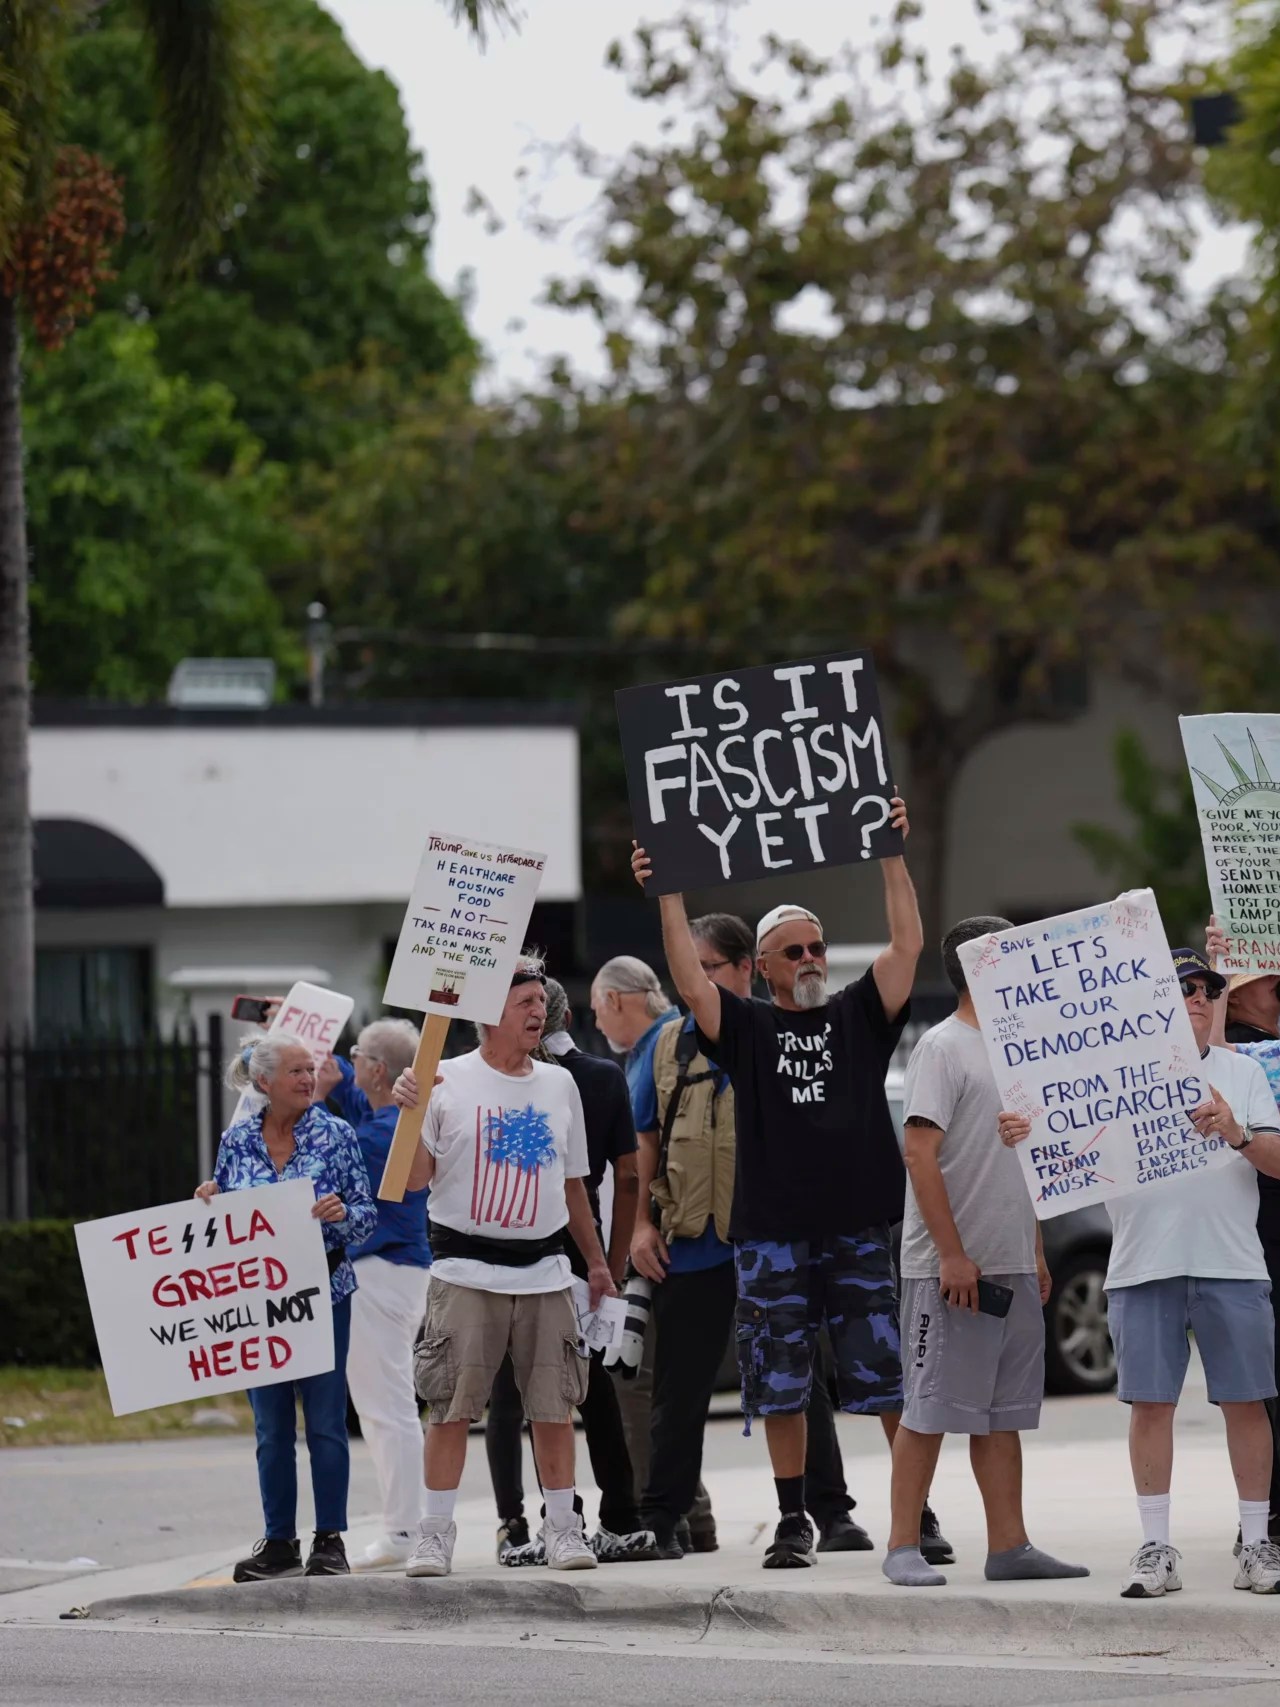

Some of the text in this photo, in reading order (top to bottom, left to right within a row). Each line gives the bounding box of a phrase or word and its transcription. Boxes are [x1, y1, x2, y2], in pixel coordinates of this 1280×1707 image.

[664, 658, 864, 740] IS IT
[1244, 809, 1264, 819] ME
[1211, 834, 1255, 843] MASSES
[1253, 846, 1279, 855] THE
[436, 860, 516, 884] HEALTHCARE
[461, 849, 478, 859] GIVE
[480, 852, 493, 862] US
[495, 853, 544, 871] AFFORDABLE
[1215, 859, 1231, 867] OF
[1235, 858, 1271, 868] YOUR
[1220, 868, 1263, 881] SEND
[448, 877, 505, 898] HOUSING
[458, 893, 491, 908] FOOD
[1224, 897, 1260, 908] TOST
[1263, 897, 1280, 909] TO
[450, 908, 488, 924] NOT
[1229, 908, 1272, 921] LAMP
[412, 917, 507, 944] TAX BREAKS FOR
[411, 943, 497, 969] AND THE RICH
[426, 935, 492, 956] ELON MUSK
[1001, 936, 1035, 954] SAVE
[1031, 935, 1107, 974] LET'S
[1223, 958, 1250, 969] THEY
[995, 957, 1151, 1010] TAKE BACK
[1155, 974, 1178, 986] SAVE
[992, 1012, 1021, 1026] SAVE
[1060, 995, 1119, 1019] OUR
[280, 1006, 339, 1044] FIRE
[997, 1021, 1026, 1034] NPR
[1002, 1007, 1176, 1067] DEMOCRACY
[791, 1081, 826, 1104] ME
[1042, 1074, 1109, 1106] FROM
[1112, 1060, 1165, 1090] THE
[1047, 1076, 1202, 1133] OLIGARCHS
[1132, 1111, 1187, 1138] HIRE
[1030, 1140, 1074, 1164] FIRE
[1137, 1127, 1197, 1156] BACK
[1035, 1150, 1101, 1179] TRUMP
[1137, 1156, 1208, 1184] GENERALS
[1041, 1171, 1099, 1201] MUSK
[152, 1256, 288, 1308] GREED
[150, 1287, 321, 1345] WE WILL NOT
[188, 1335, 293, 1382] HEED
